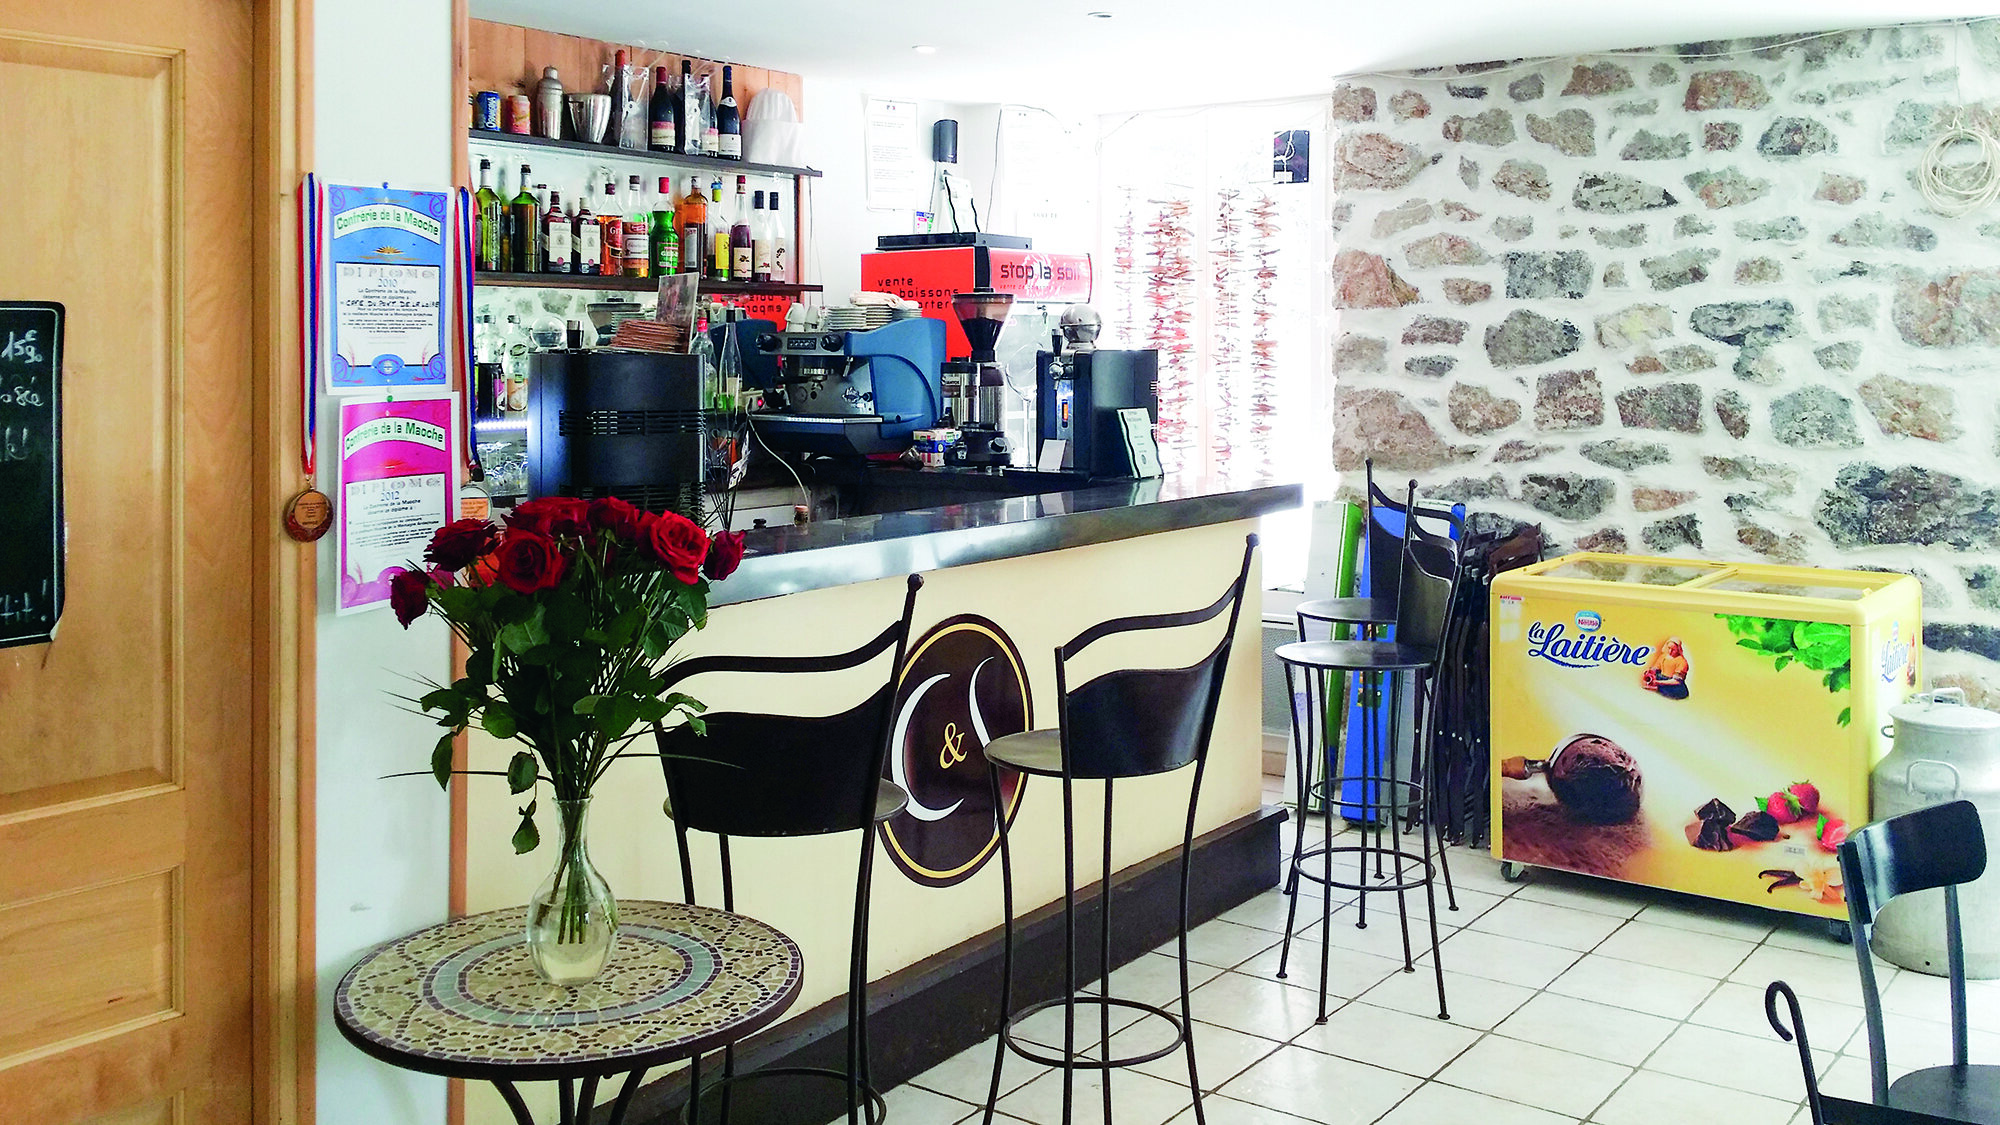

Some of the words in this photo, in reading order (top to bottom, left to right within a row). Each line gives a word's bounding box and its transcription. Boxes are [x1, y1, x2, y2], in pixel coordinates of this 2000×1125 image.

[380, 209, 390, 221] de
[393, 209, 401, 222] la
[404, 211, 439, 236] Maoche
[378, 278, 398, 288] 2010
[878, 277, 913, 287] vente
[1000, 262, 1034, 285] stop
[1039, 261, 1052, 280] la
[381, 422, 391, 434] de
[394, 421, 402, 433] la
[405, 421, 443, 443] Maoche
[381, 490, 400, 501] 2012
[1528, 621, 1545, 640] la
[1528, 624, 1650, 668] Laitière
[939, 721, 968, 769] &
